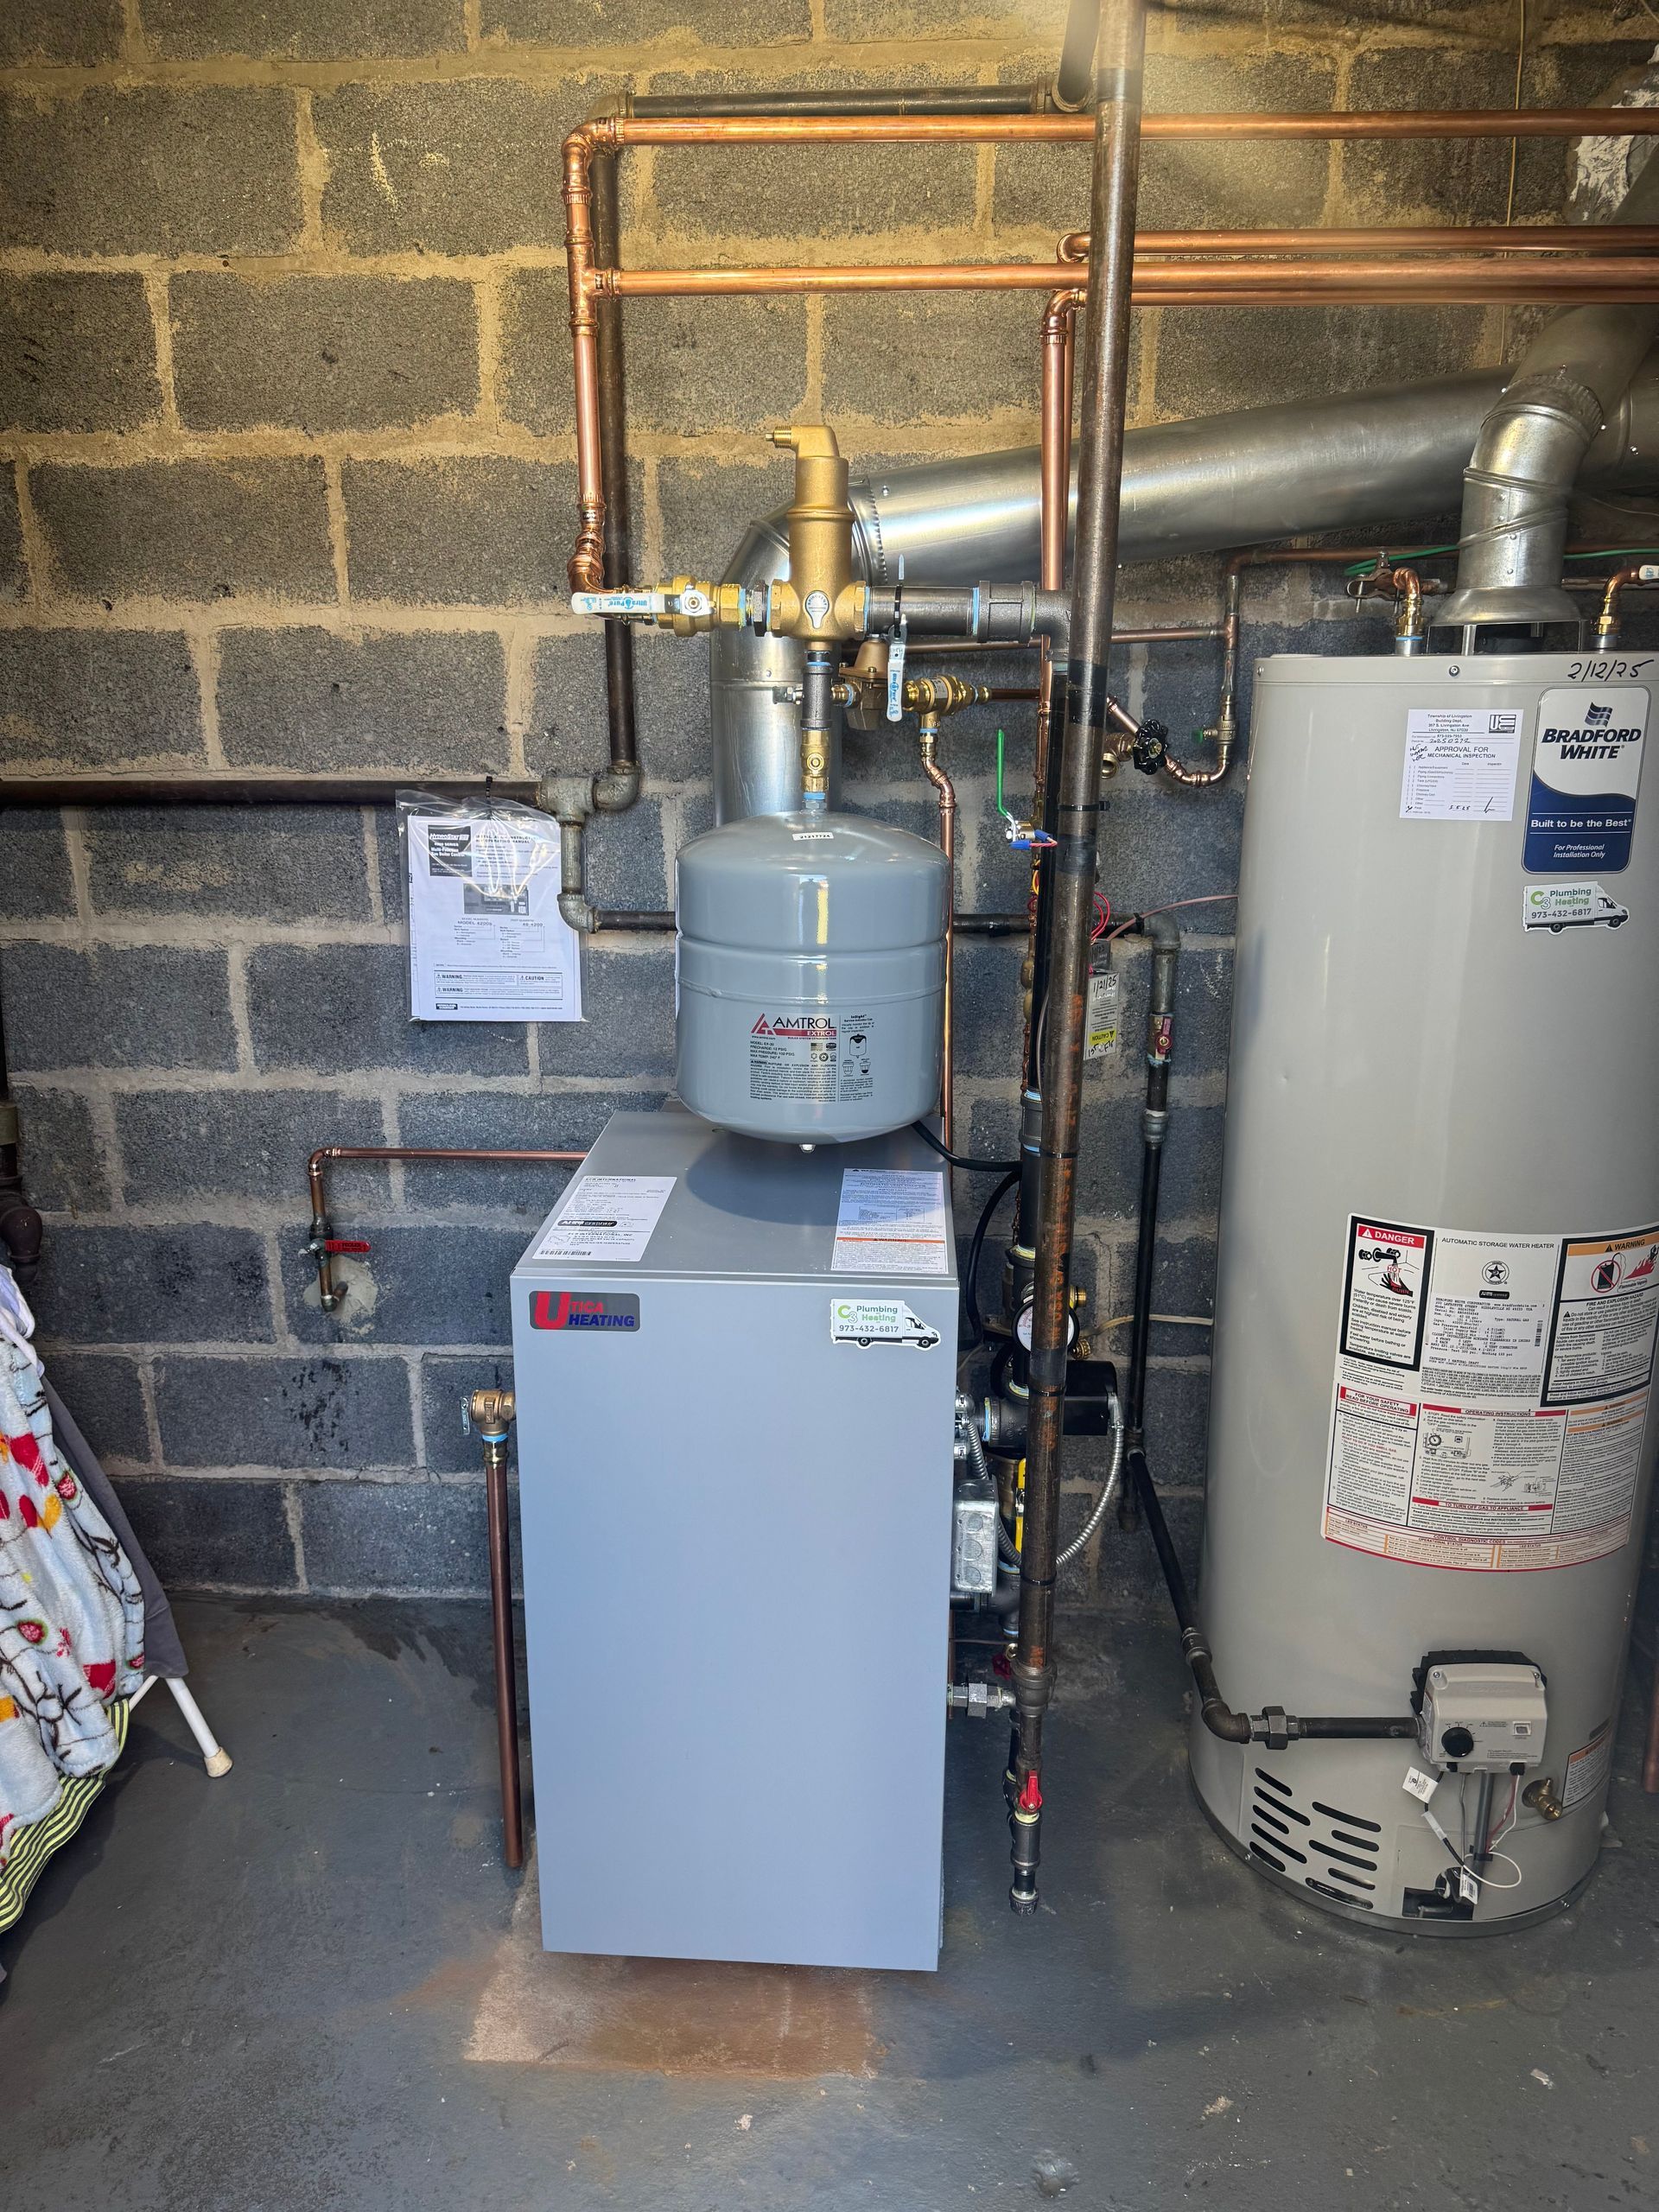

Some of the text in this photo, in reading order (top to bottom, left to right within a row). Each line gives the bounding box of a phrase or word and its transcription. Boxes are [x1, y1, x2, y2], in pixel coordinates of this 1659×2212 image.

[1541, 728, 1641, 743] BRADFORD
[1550, 888, 1591, 897] Plumbing
[1532, 908, 1592, 918] 973-432-6817
[772, 1017, 836, 1029] AMTROL
[1375, 1231, 1414, 1244] DANGER
[1442, 1237, 1477, 1246] AUTOMATIC
[1615, 1239, 1644, 1250] WARNING
[1366, 1290, 1390, 1300] temperature
[534, 1292, 604, 1329] UTICA
[569, 1314, 635, 1326] HEATING
[1360, 1319, 1380, 1328] instruction
[1365, 1325, 1389, 1334] temperature
[1350, 1342, 1373, 1351] Temperature
[1360, 1397, 1378, 1407] BEFORE
[1380, 1403, 1408, 1413] OPERATING
